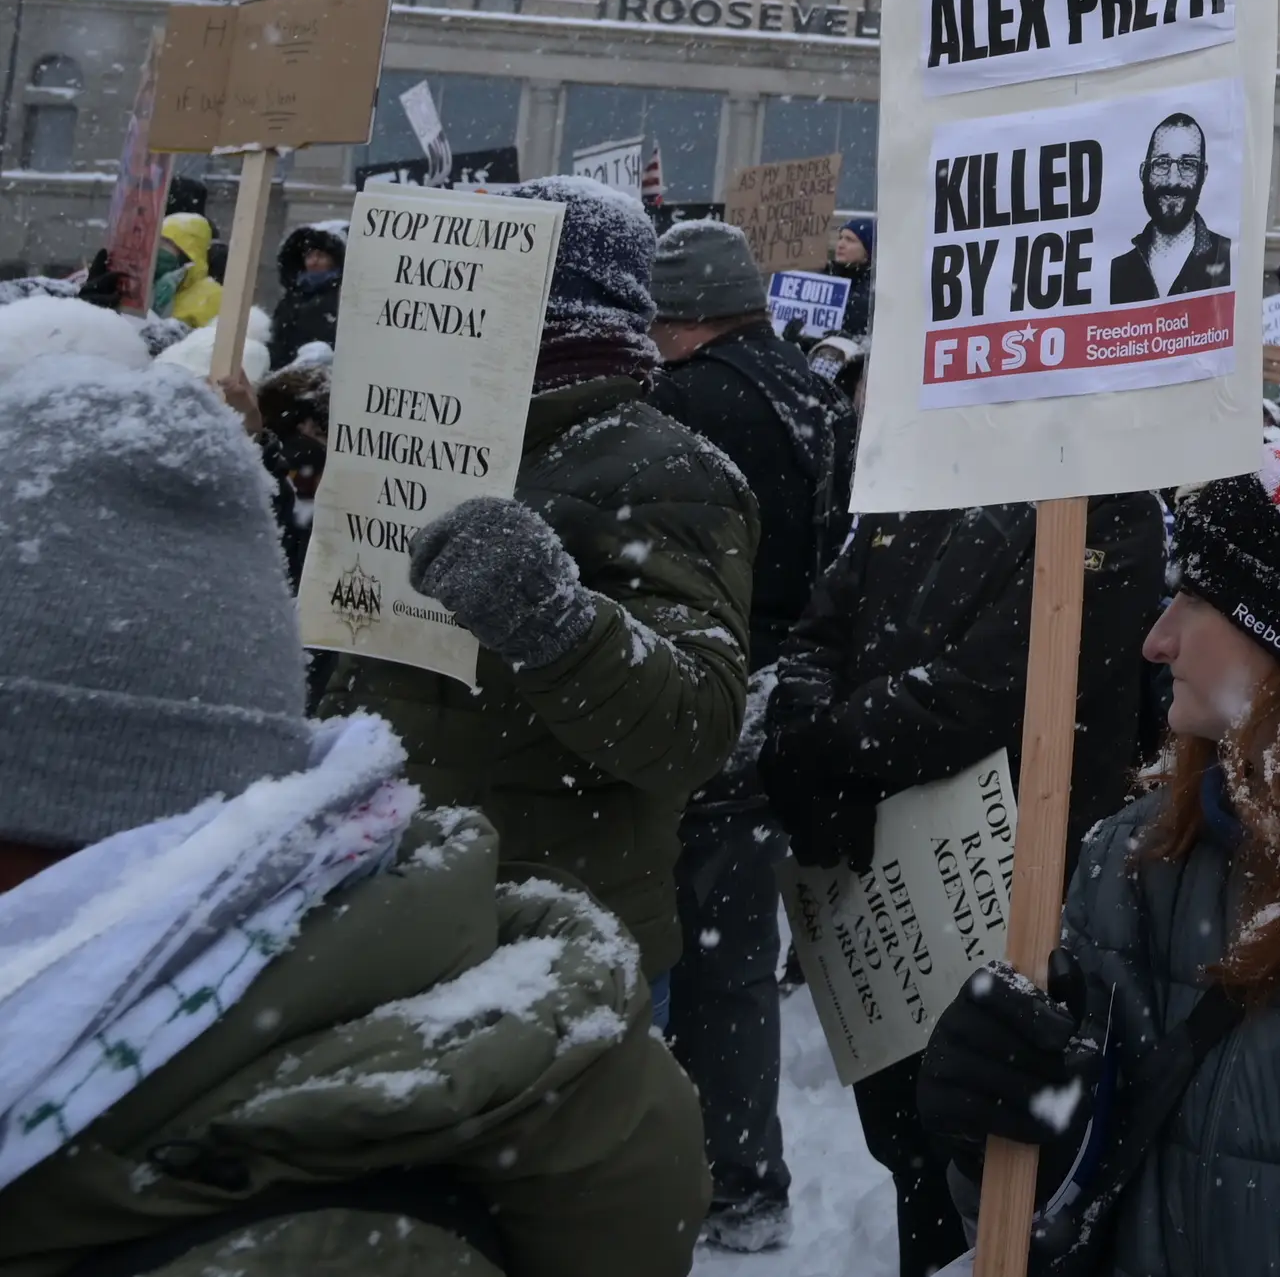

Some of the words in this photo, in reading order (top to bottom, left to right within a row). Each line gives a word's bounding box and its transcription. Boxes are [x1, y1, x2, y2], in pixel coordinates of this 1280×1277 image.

[739, 170, 756, 192] AS
[762, 165, 781, 185] MY
[785, 157, 832, 182] TEMPER
[760, 183, 796, 204] WHEN
[363, 207, 430, 243] STOP
[432, 213, 537, 254] TRUMP'S
[394, 254, 484, 292] RACIST
[779, 275, 800, 300] ICE
[800, 278, 834, 305] OUT!
[375, 298, 487, 339] AGENDA!
[811, 306, 838, 331] ICE!
[364, 383, 462, 427] DEFEND
[333, 423, 491, 478] IMMIGRANTS
[376, 475, 427, 512] AND
[346, 512, 420, 554] WORK
[330, 578, 382, 615] AAAN
[392, 599, 459, 628] @aaanma
[976, 769, 1013, 847] STOP
[930, 836, 986, 963] AGENDA!
[960, 829, 1007, 932] RACIST
[882, 858, 934, 976] DEFEND
[826, 879, 884, 1026] WRKERS!
[852, 912, 883, 972] AND
